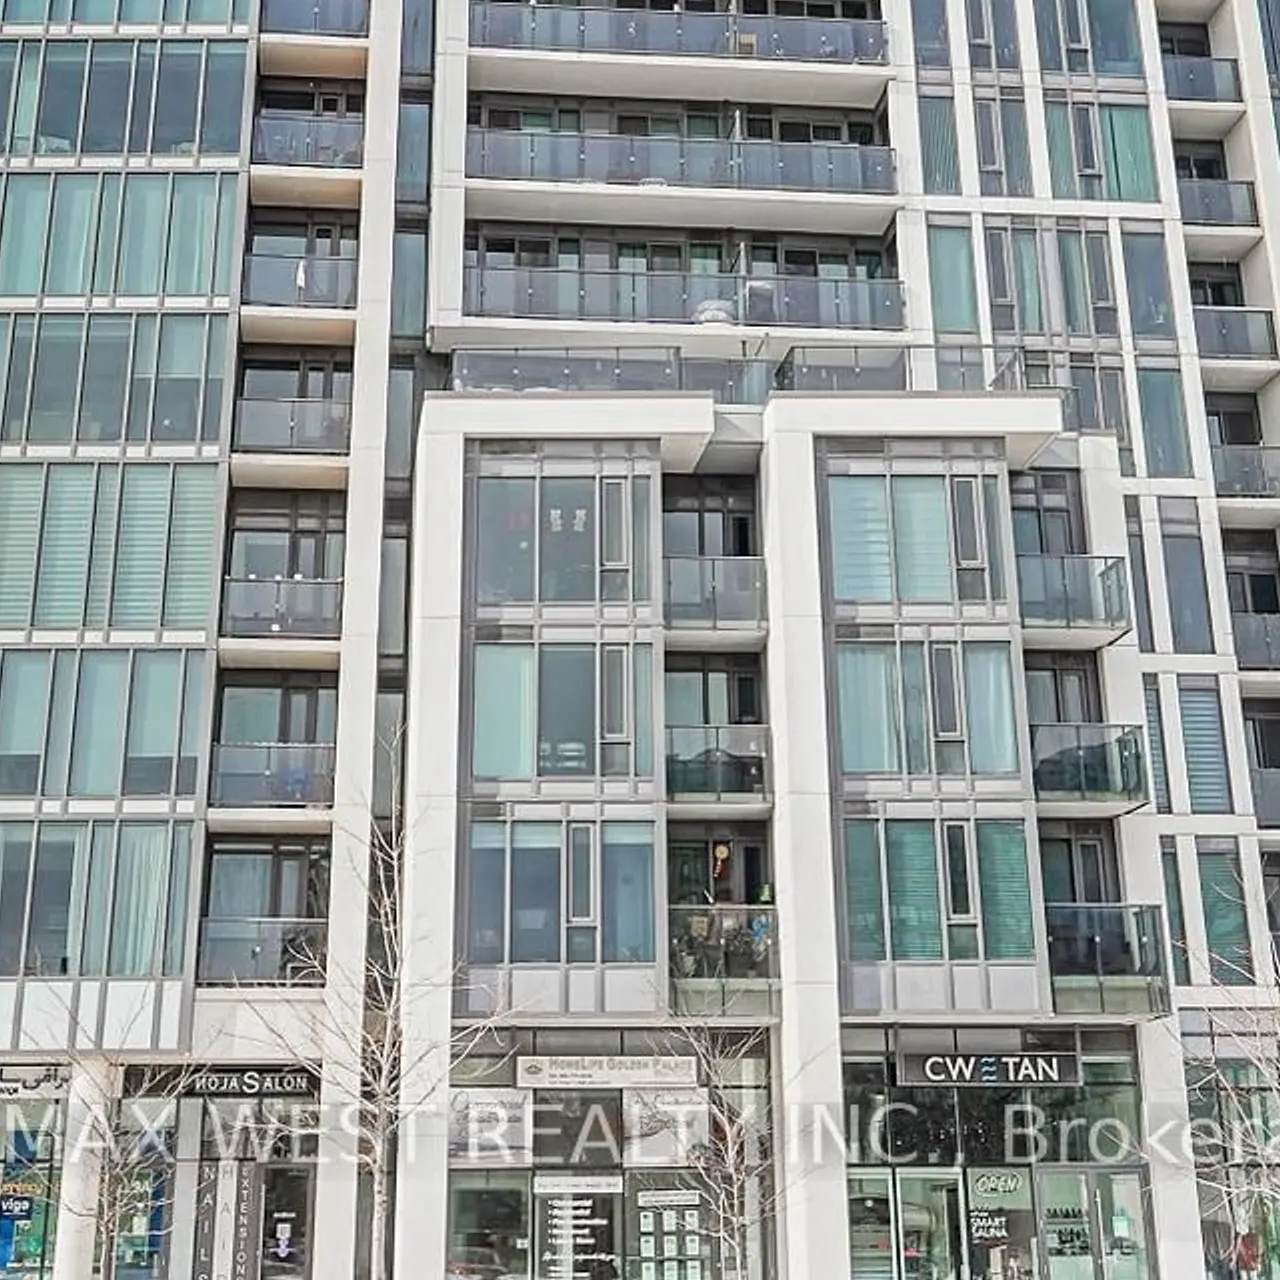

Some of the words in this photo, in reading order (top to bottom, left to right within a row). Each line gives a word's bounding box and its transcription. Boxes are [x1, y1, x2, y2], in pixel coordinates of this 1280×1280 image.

[925, 1056, 976, 1081] CW
[1001, 1056, 1059, 1081] TAN
[978, 1175, 1018, 1191] OPEN
